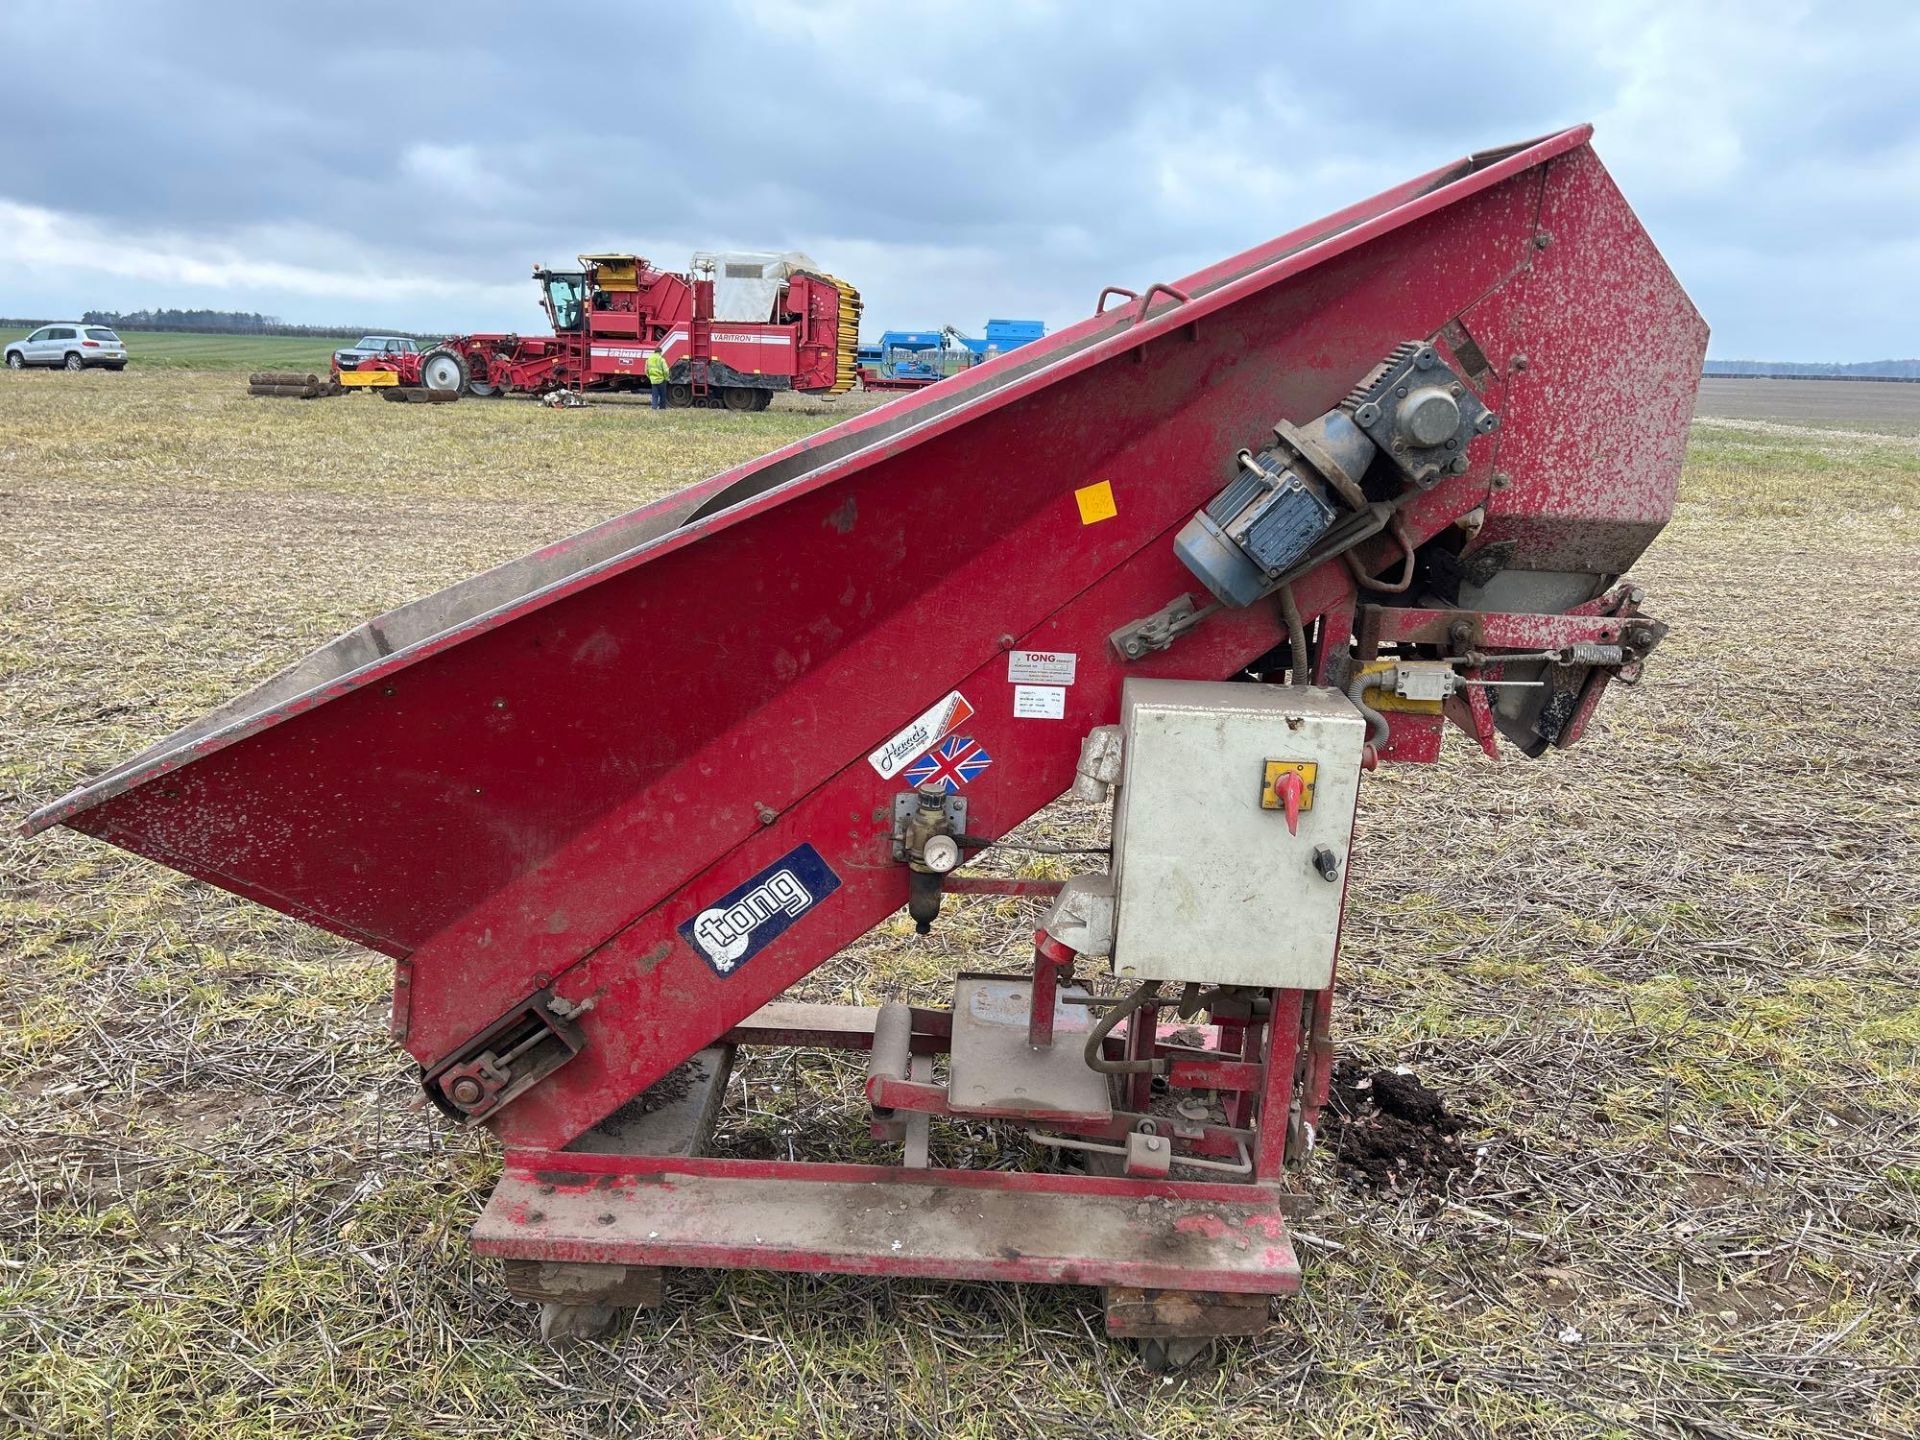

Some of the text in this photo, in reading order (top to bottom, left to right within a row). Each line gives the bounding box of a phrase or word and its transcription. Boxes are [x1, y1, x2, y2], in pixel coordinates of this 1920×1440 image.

[714, 334, 751, 342] VARITRON
[1026, 654, 1055, 662] TONG
[699, 869, 813, 948] tong
